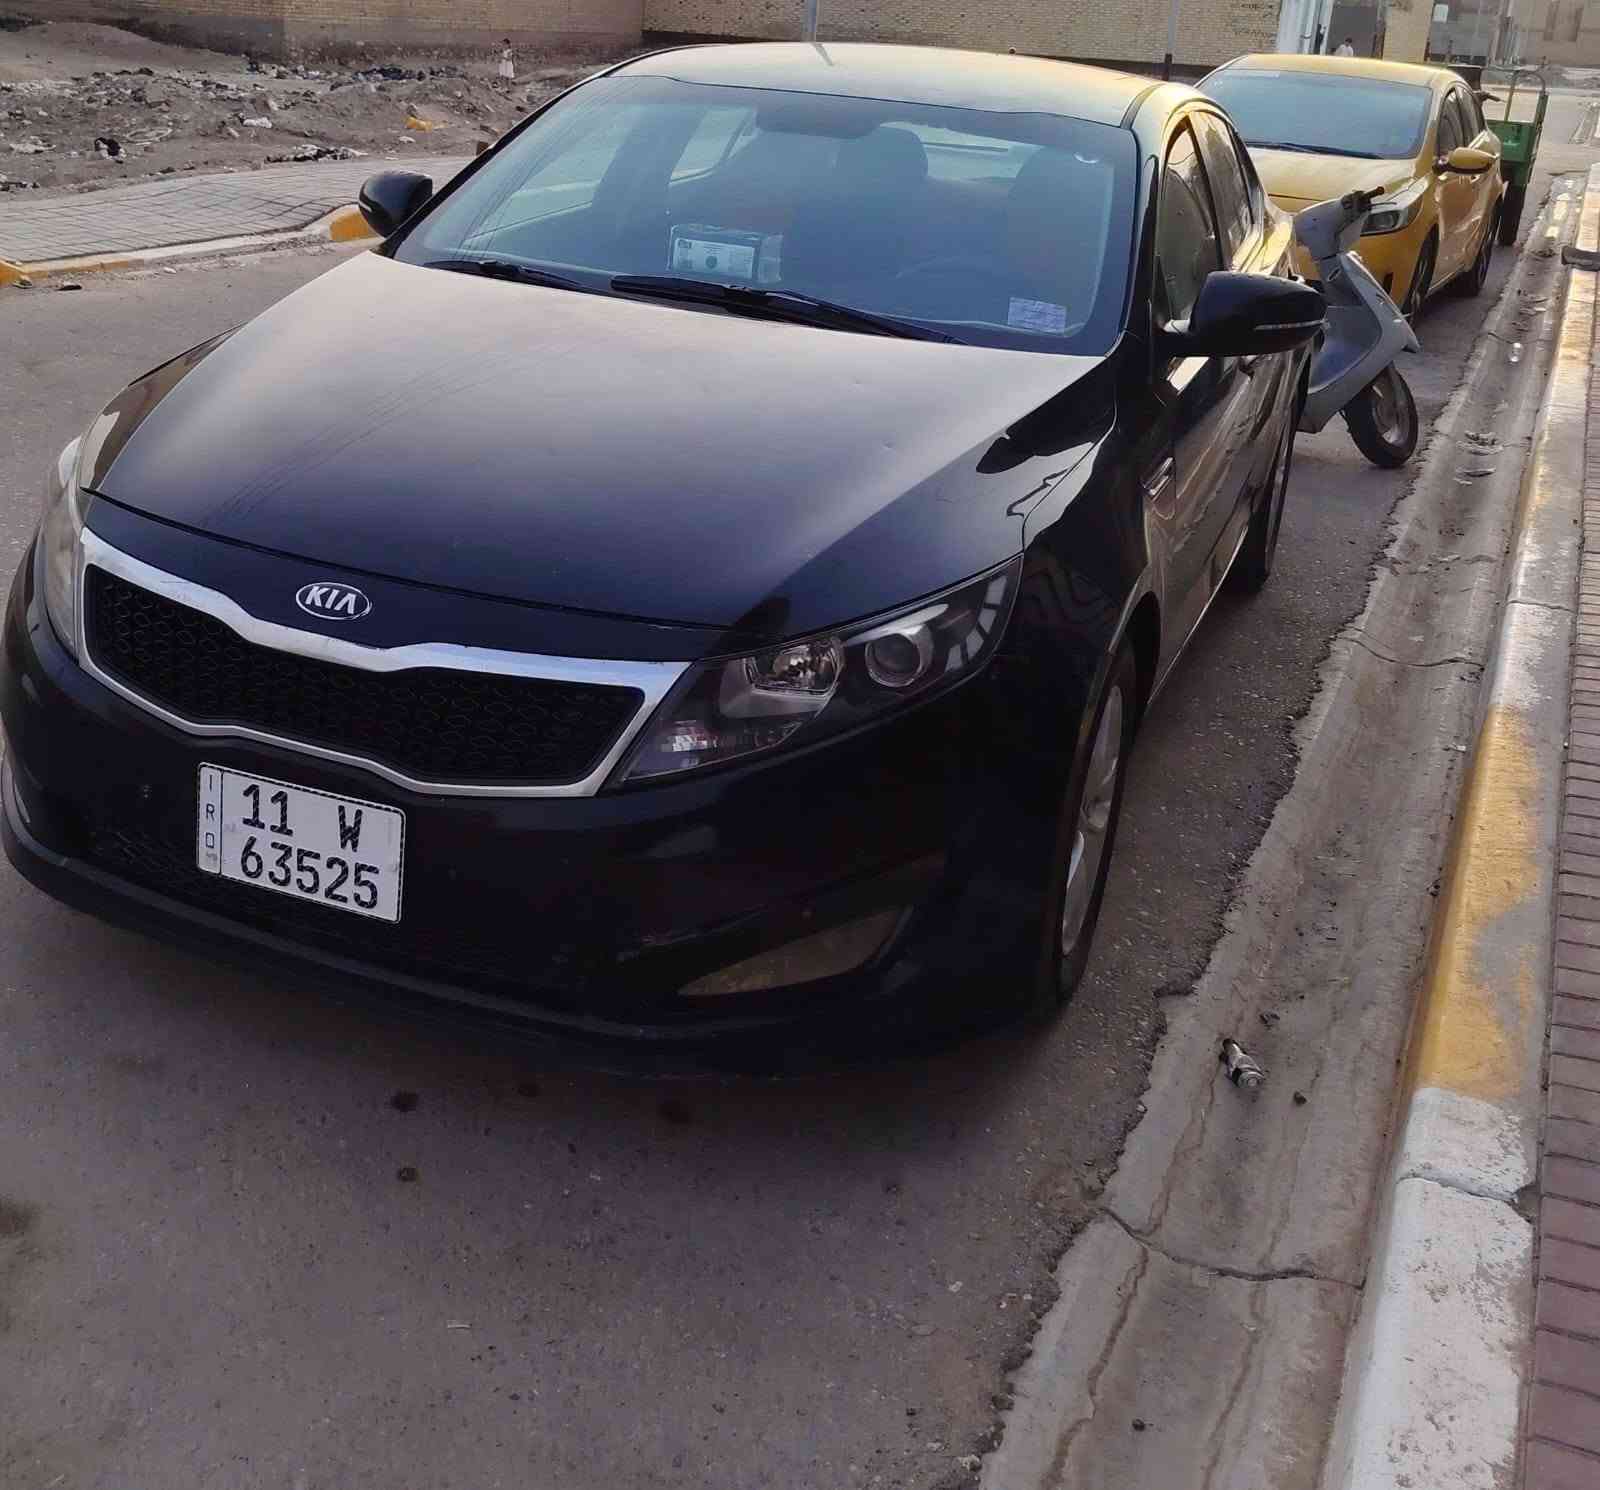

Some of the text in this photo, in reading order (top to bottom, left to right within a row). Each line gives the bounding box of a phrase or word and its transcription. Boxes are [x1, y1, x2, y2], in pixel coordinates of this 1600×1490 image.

[304, 585, 357, 615] KIA
[242, 783, 363, 853] 11 W
[240, 835, 380, 909] 63525
